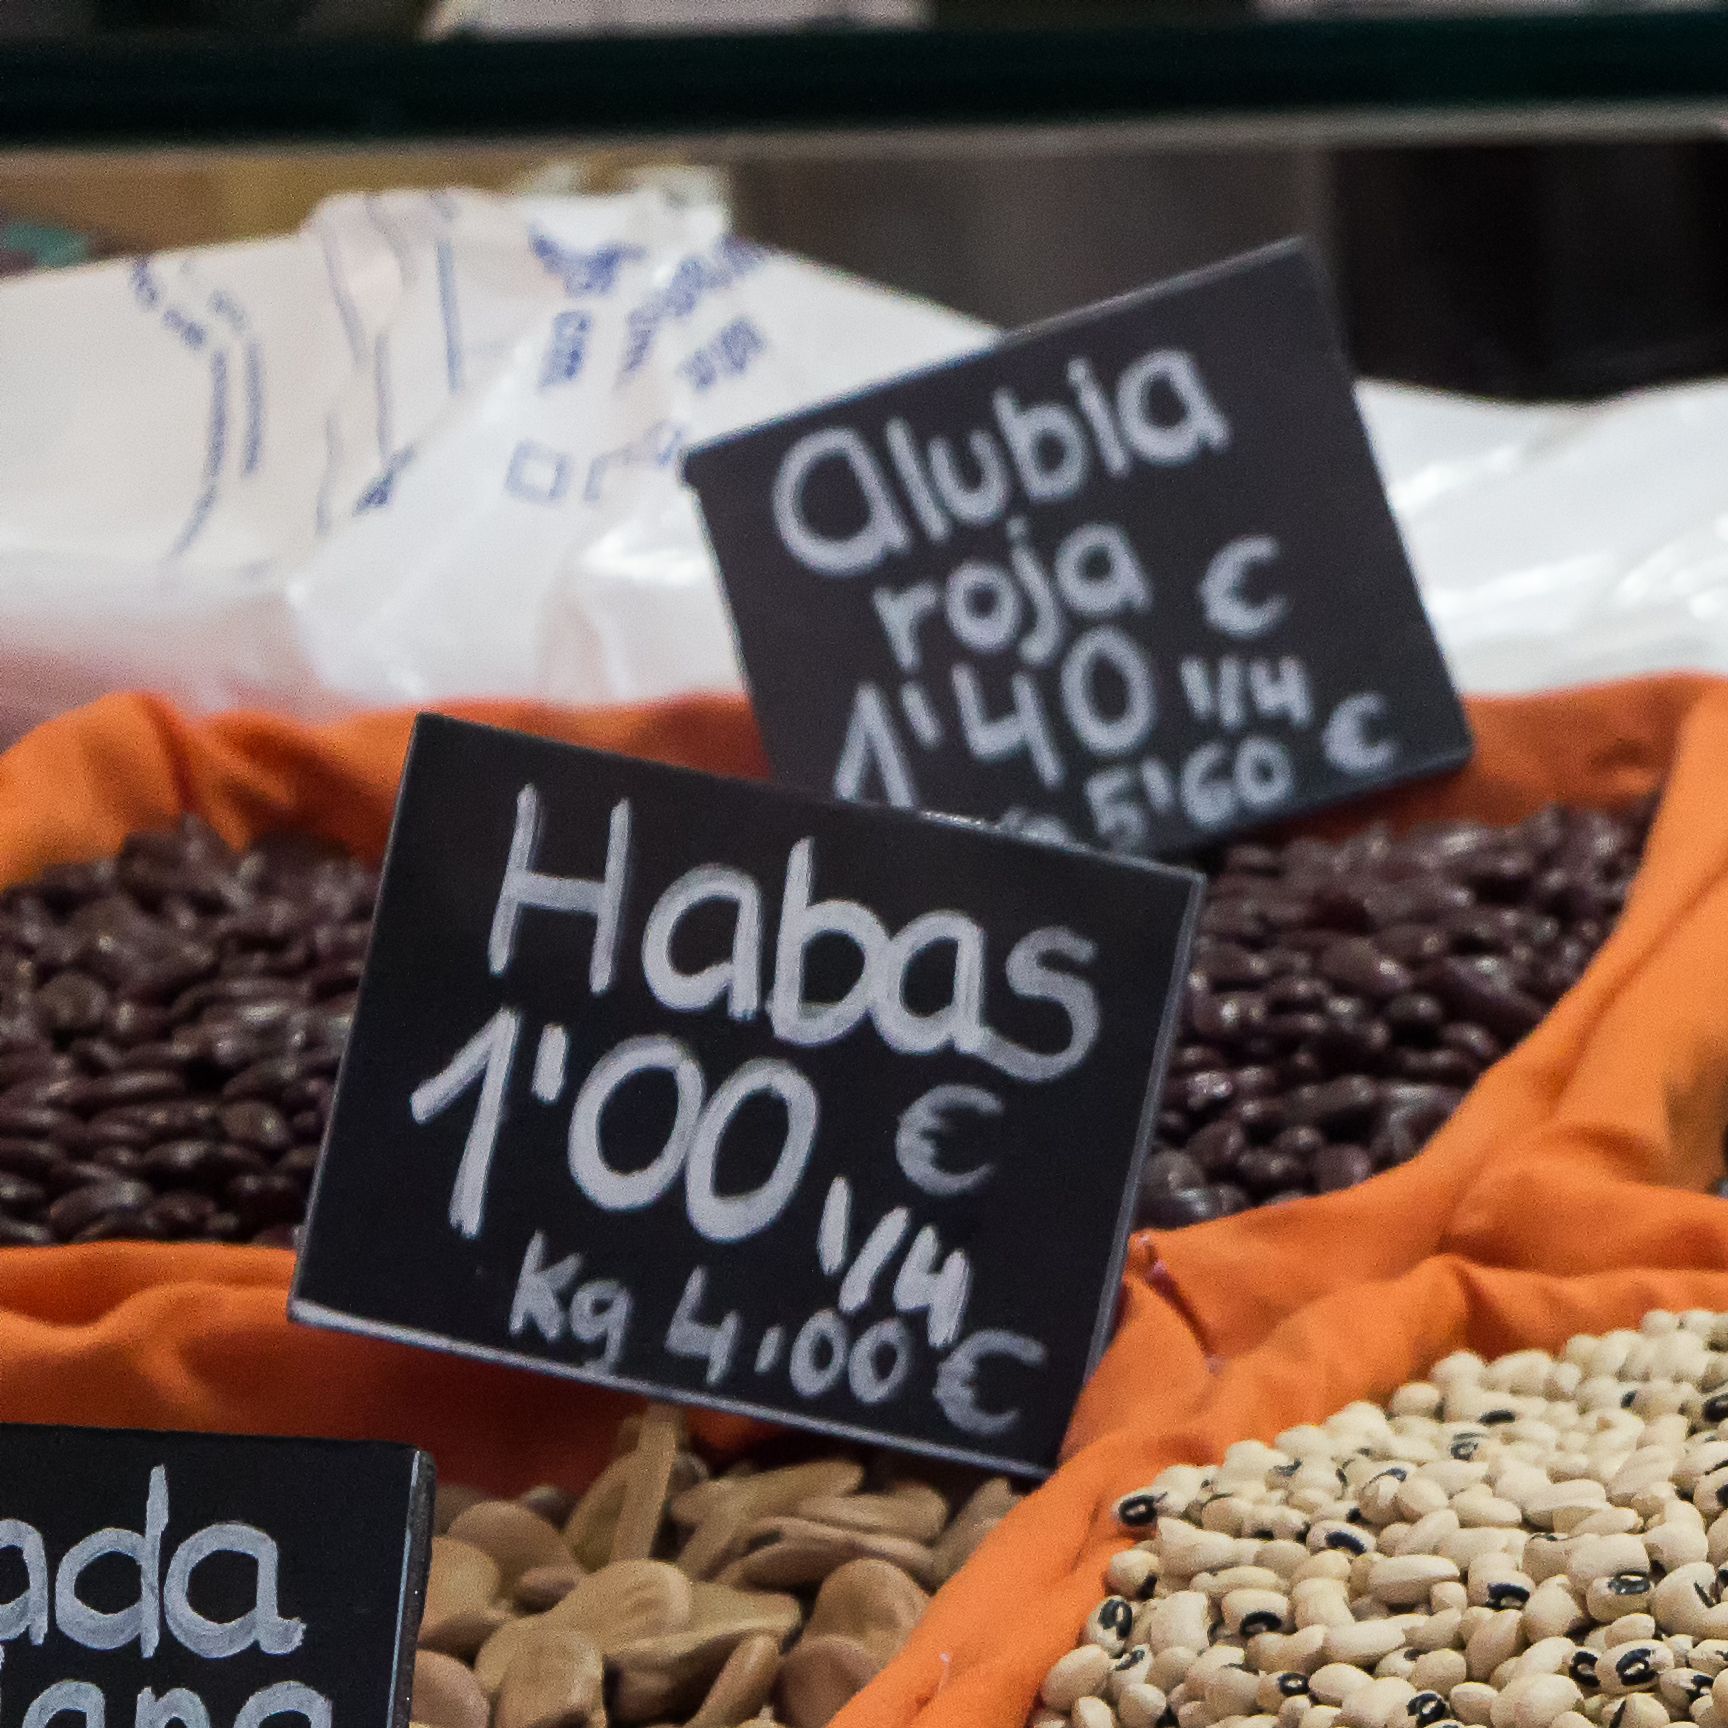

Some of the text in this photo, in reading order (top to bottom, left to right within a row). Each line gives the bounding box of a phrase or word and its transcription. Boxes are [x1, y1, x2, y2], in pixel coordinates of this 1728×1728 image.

[871, 515, 1152, 673] roja
[488, 783, 1102, 1084] Habas
[410, 1007, 1004, 1244] 1'00 €
